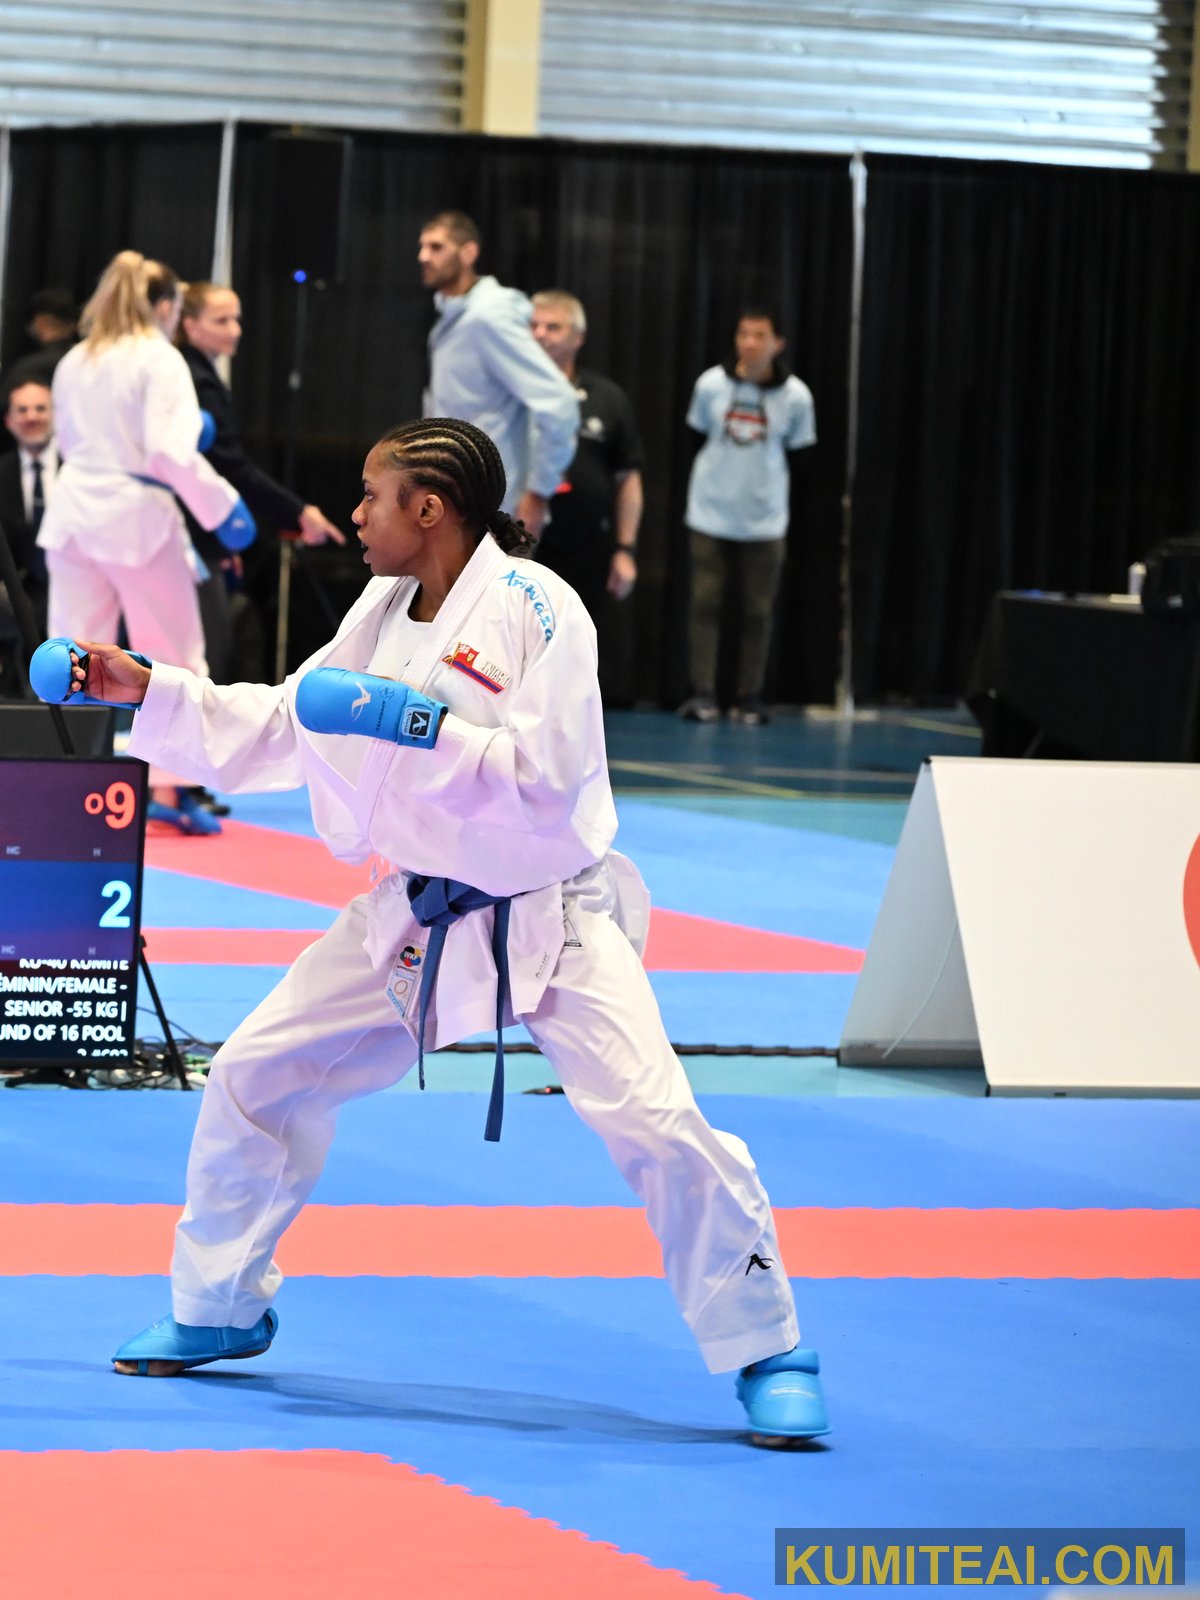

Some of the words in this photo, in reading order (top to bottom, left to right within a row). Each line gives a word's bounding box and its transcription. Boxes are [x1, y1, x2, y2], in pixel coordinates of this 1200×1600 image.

[99, 880, 132, 928] 2
[4, 1000, 63, 1017] SENIOR
[66, 1001, 92, 1018] -55
[95, 1001, 118, 1018] KG
[33, 1024, 56, 1041] OF
[60, 1024, 79, 1041] 16
[82, 1025, 126, 1042] POOL
